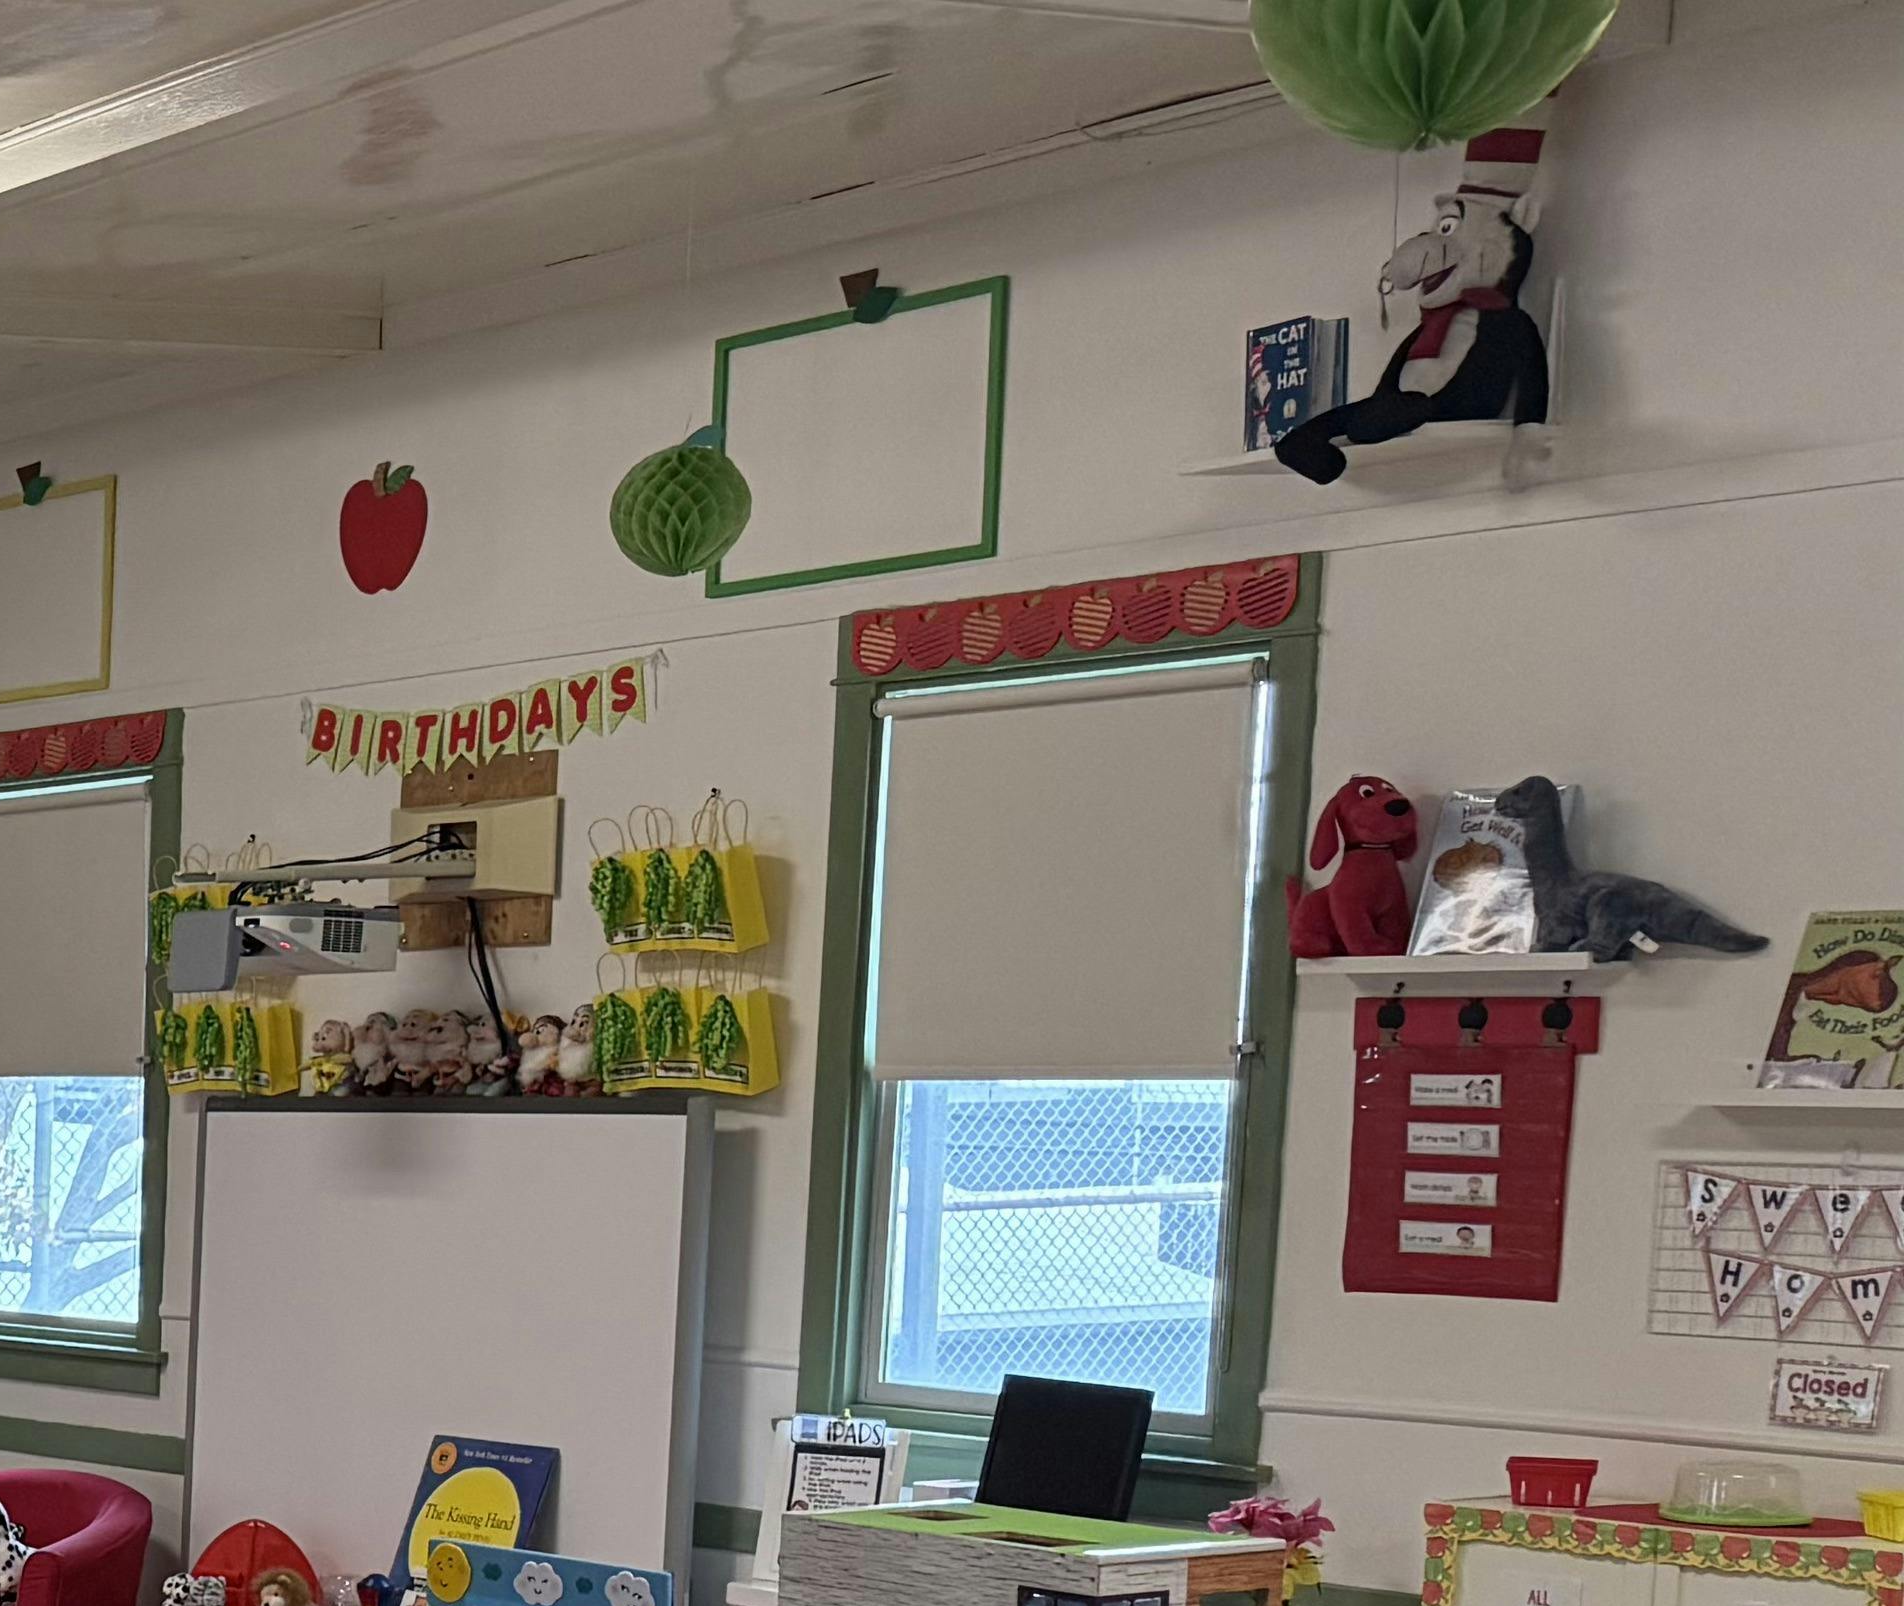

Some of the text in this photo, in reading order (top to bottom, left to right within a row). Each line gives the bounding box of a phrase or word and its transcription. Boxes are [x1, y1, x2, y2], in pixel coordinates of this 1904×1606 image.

[1278, 322, 1307, 345] CAT
[1277, 368, 1307, 390] HAT
[312, 664, 639, 762] BIRTHDAYS
[1460, 820, 1515, 839] Get Well
[1813, 930, 1875, 959] How Do
[1830, 1018, 1867, 1034] Their
[1787, 1372, 1869, 1399] Closed
[424, 1503, 516, 1531] The Kissing Hand
[1527, 1590, 1550, 1606] ALL
